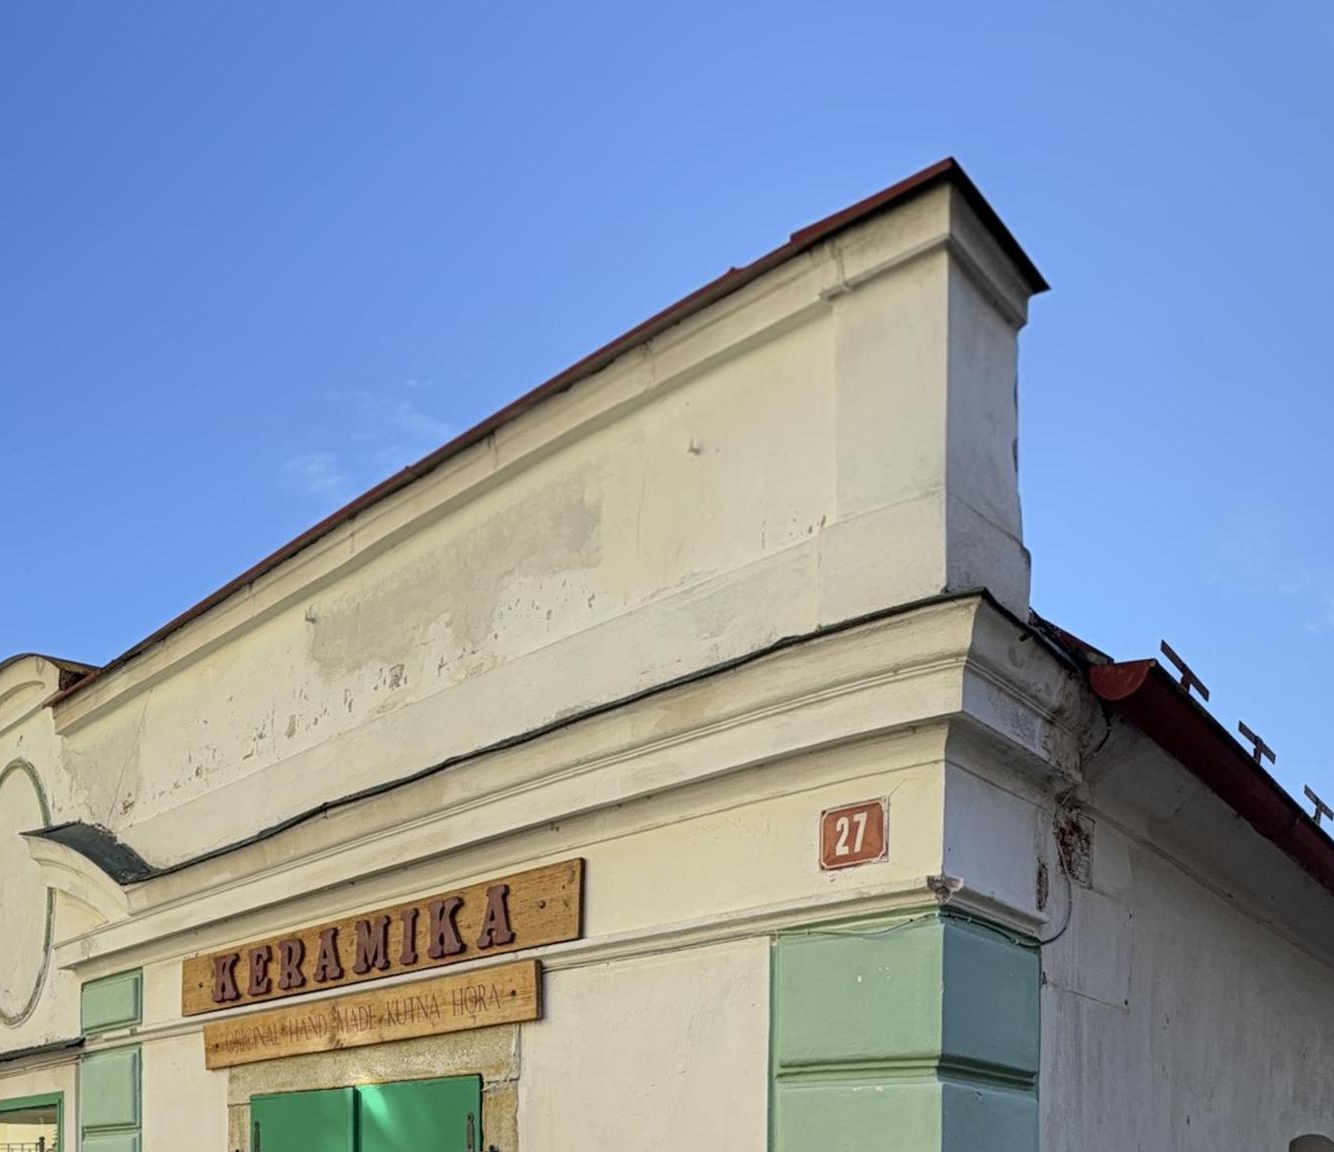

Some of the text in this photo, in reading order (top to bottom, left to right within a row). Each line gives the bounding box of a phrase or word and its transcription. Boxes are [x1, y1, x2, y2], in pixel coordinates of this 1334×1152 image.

[835, 812, 868, 857] 27
[213, 885, 515, 1003] KERAMIKA
[288, 1013, 328, 1043] HAND
[334, 1004, 377, 1033] MADE
[451, 983, 501, 1017] HORA
